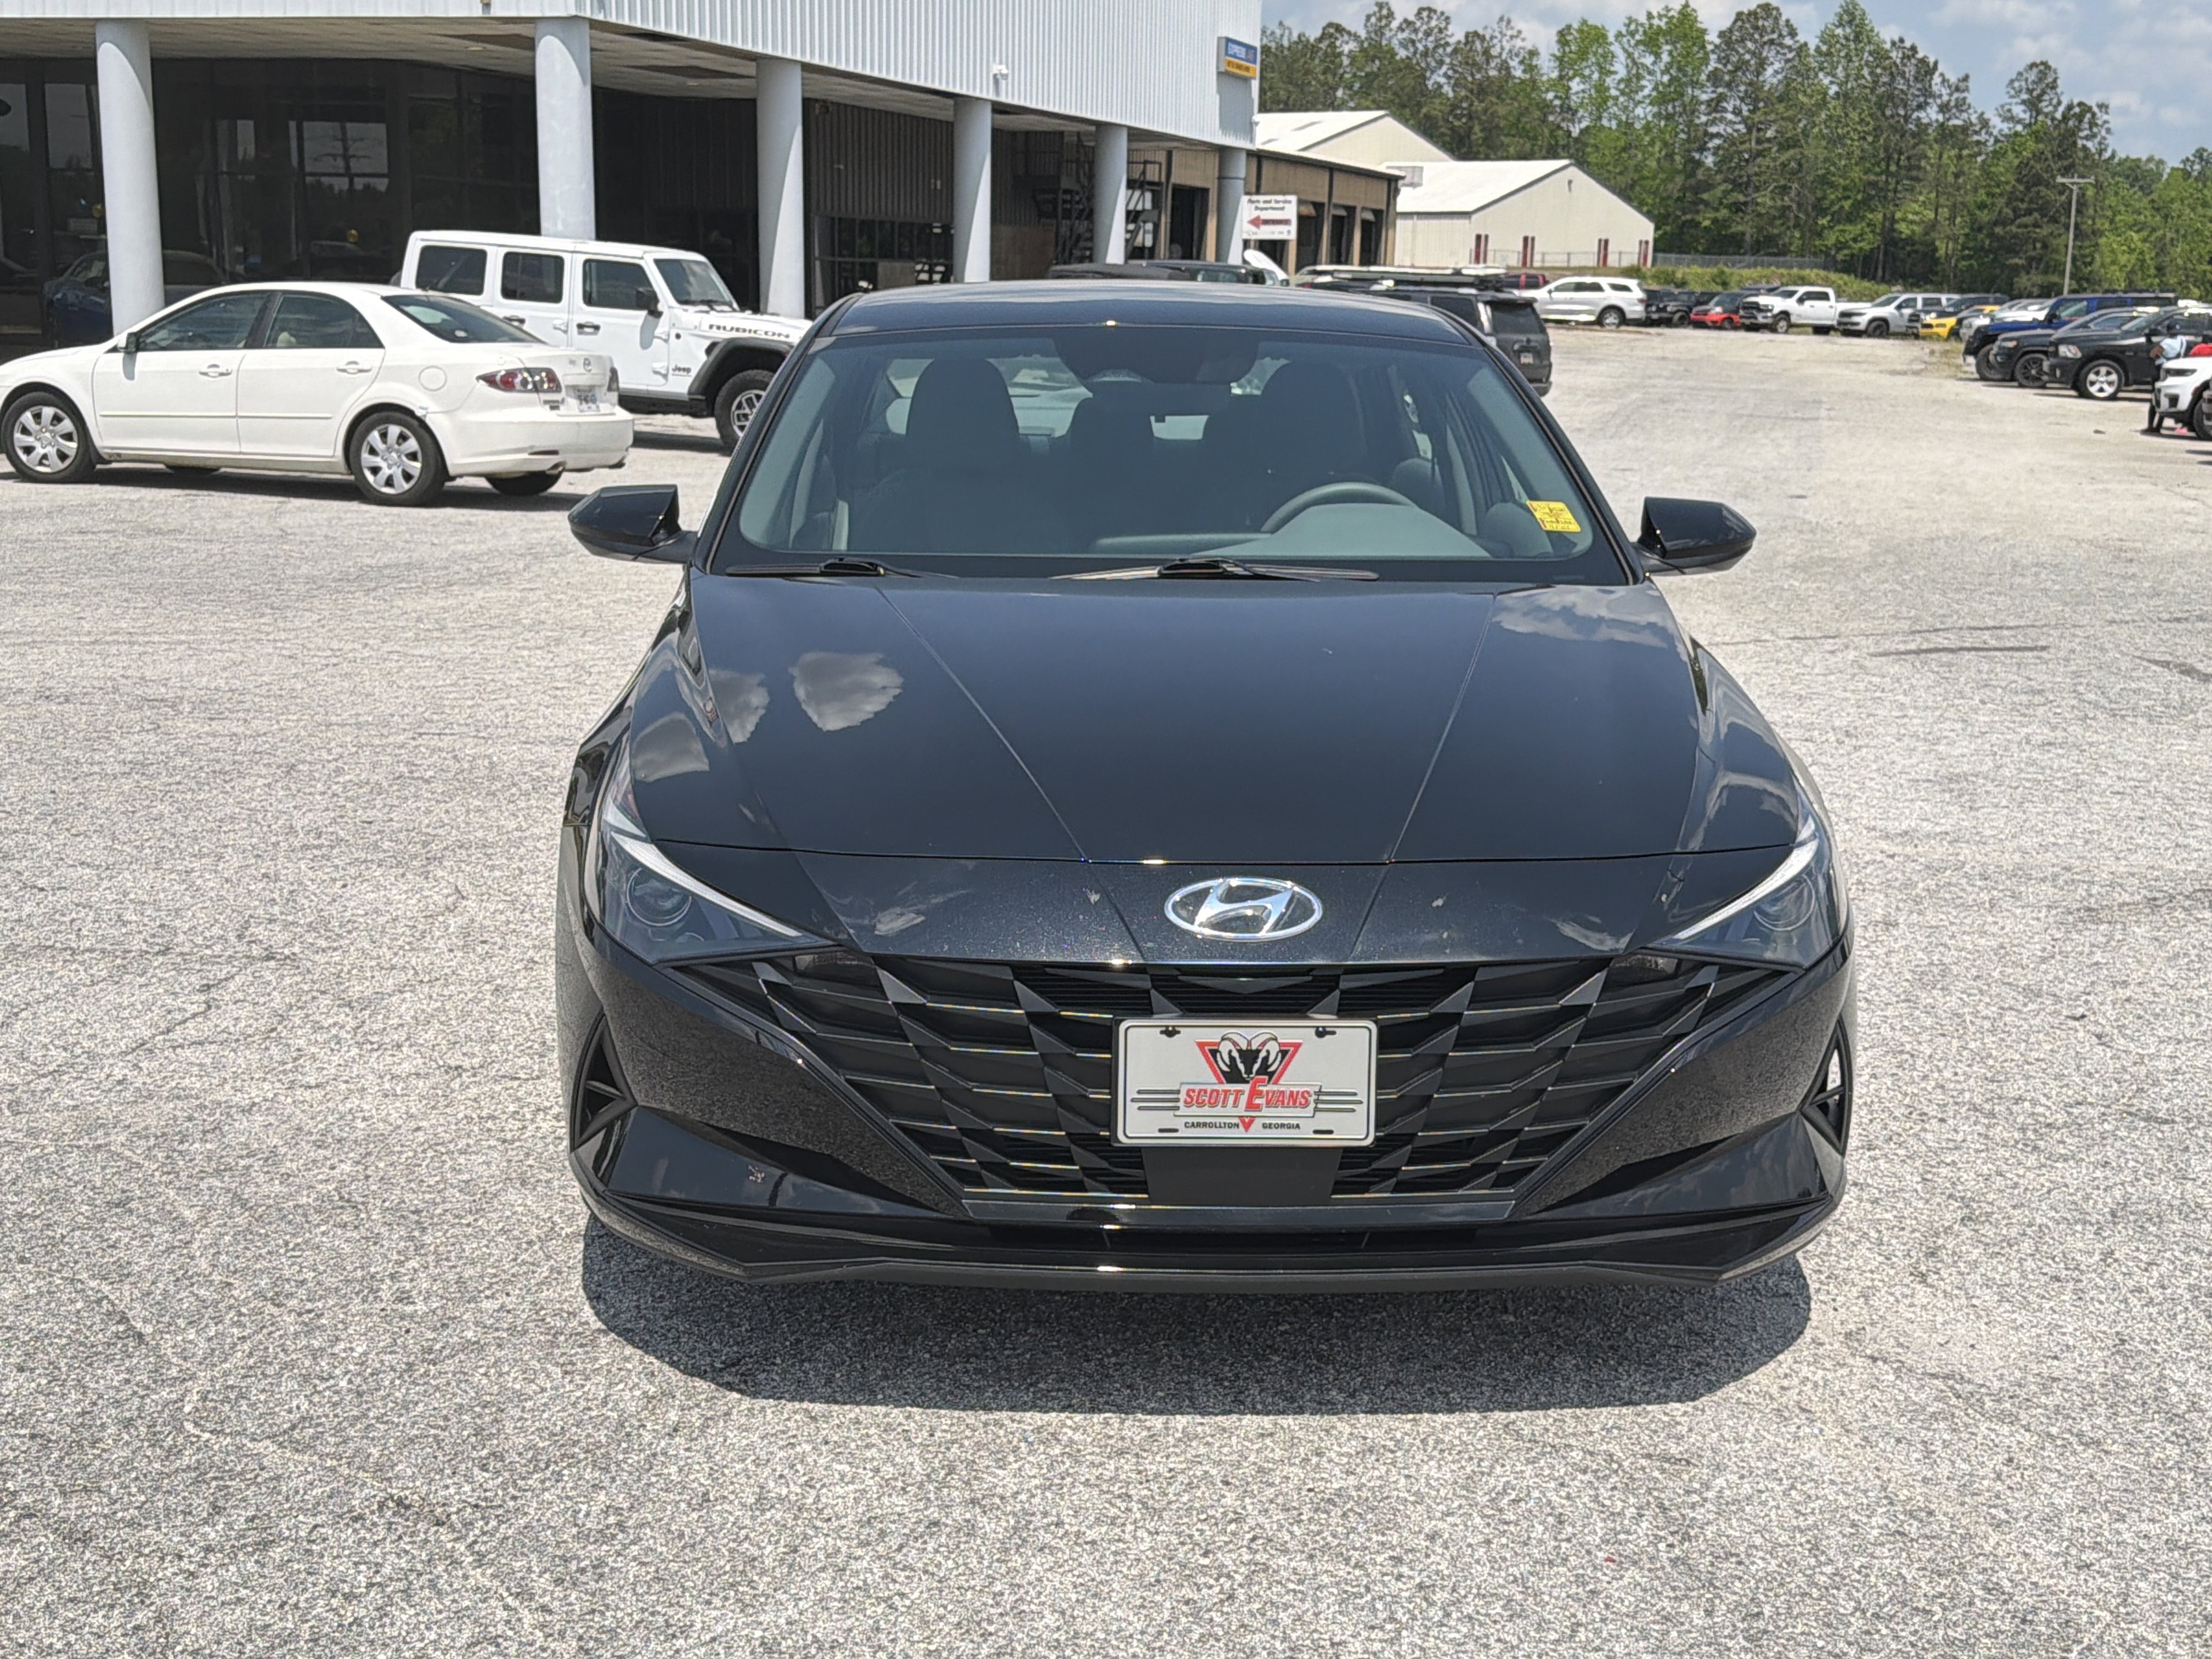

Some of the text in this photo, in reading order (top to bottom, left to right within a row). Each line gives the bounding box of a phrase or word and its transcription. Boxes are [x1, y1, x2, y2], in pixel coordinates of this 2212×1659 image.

[709, 324, 790, 338] RUBICON
[672, 364, 692, 375] Jeep
[1183, 1076, 1312, 1111] SCOTT EVANS
